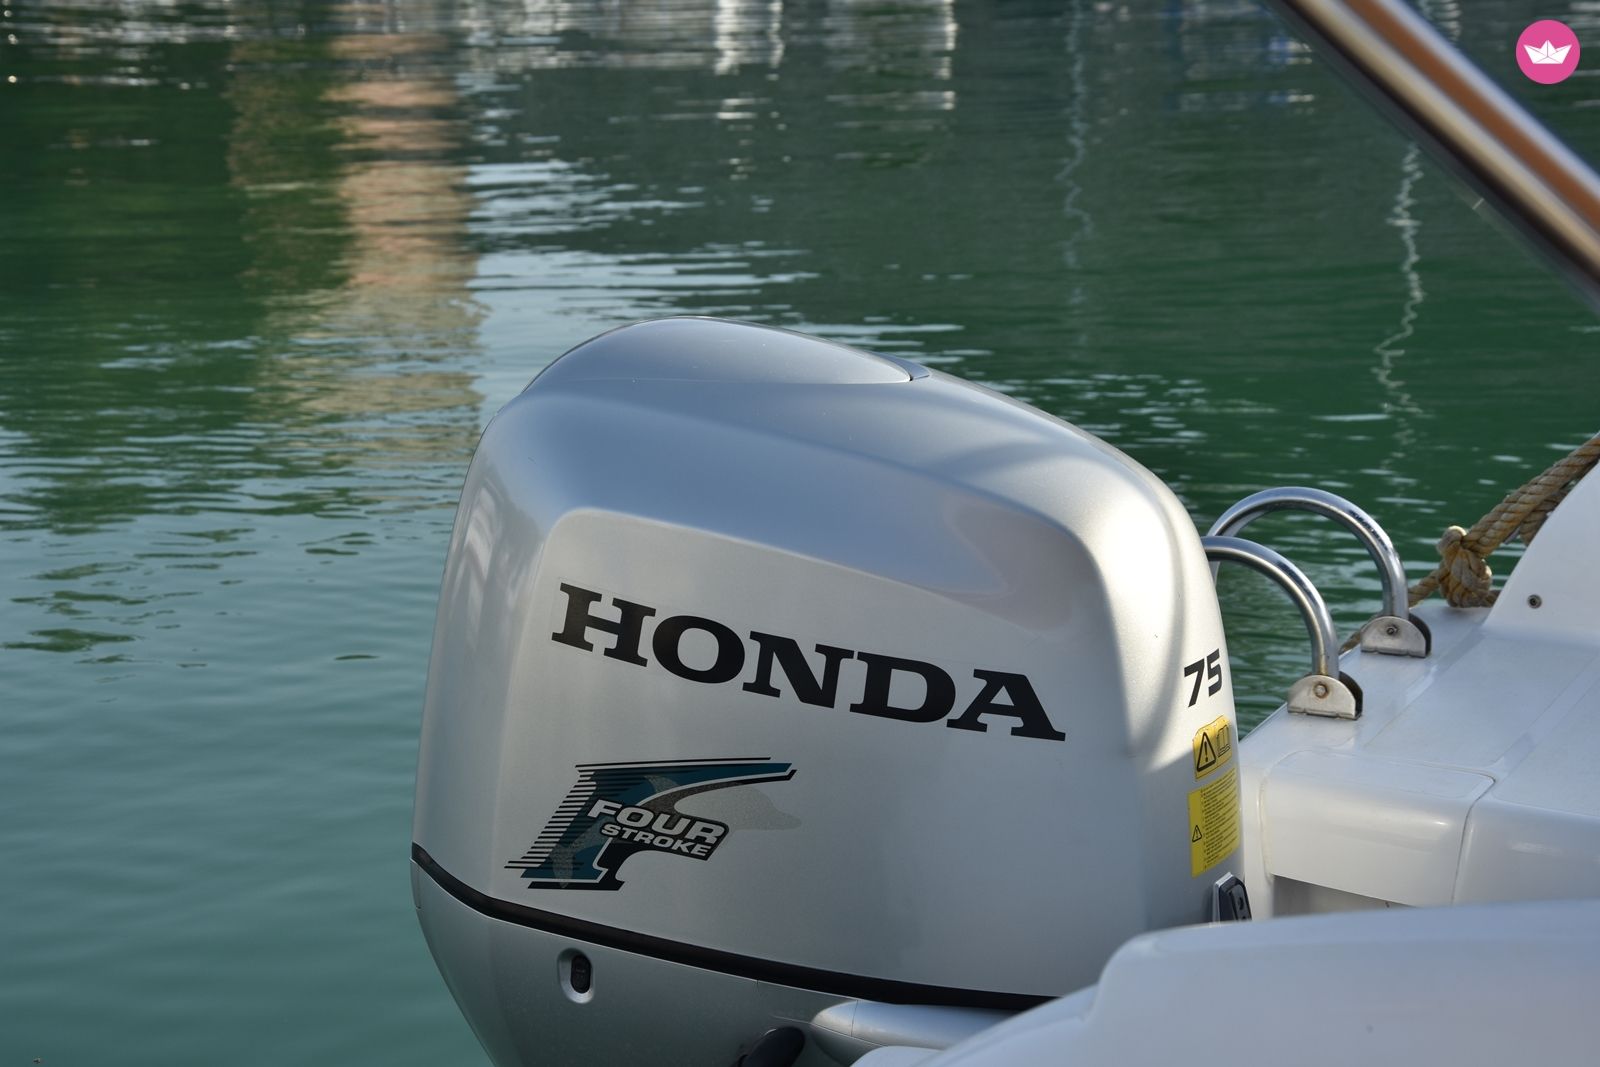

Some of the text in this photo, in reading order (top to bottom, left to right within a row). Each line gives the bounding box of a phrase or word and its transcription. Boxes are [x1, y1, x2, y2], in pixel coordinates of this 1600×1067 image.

[551, 582, 1066, 741] HONDA
[1183, 648, 1222, 708] 75
[587, 799, 725, 844] FOUR
[601, 824, 711, 856] STROKE
